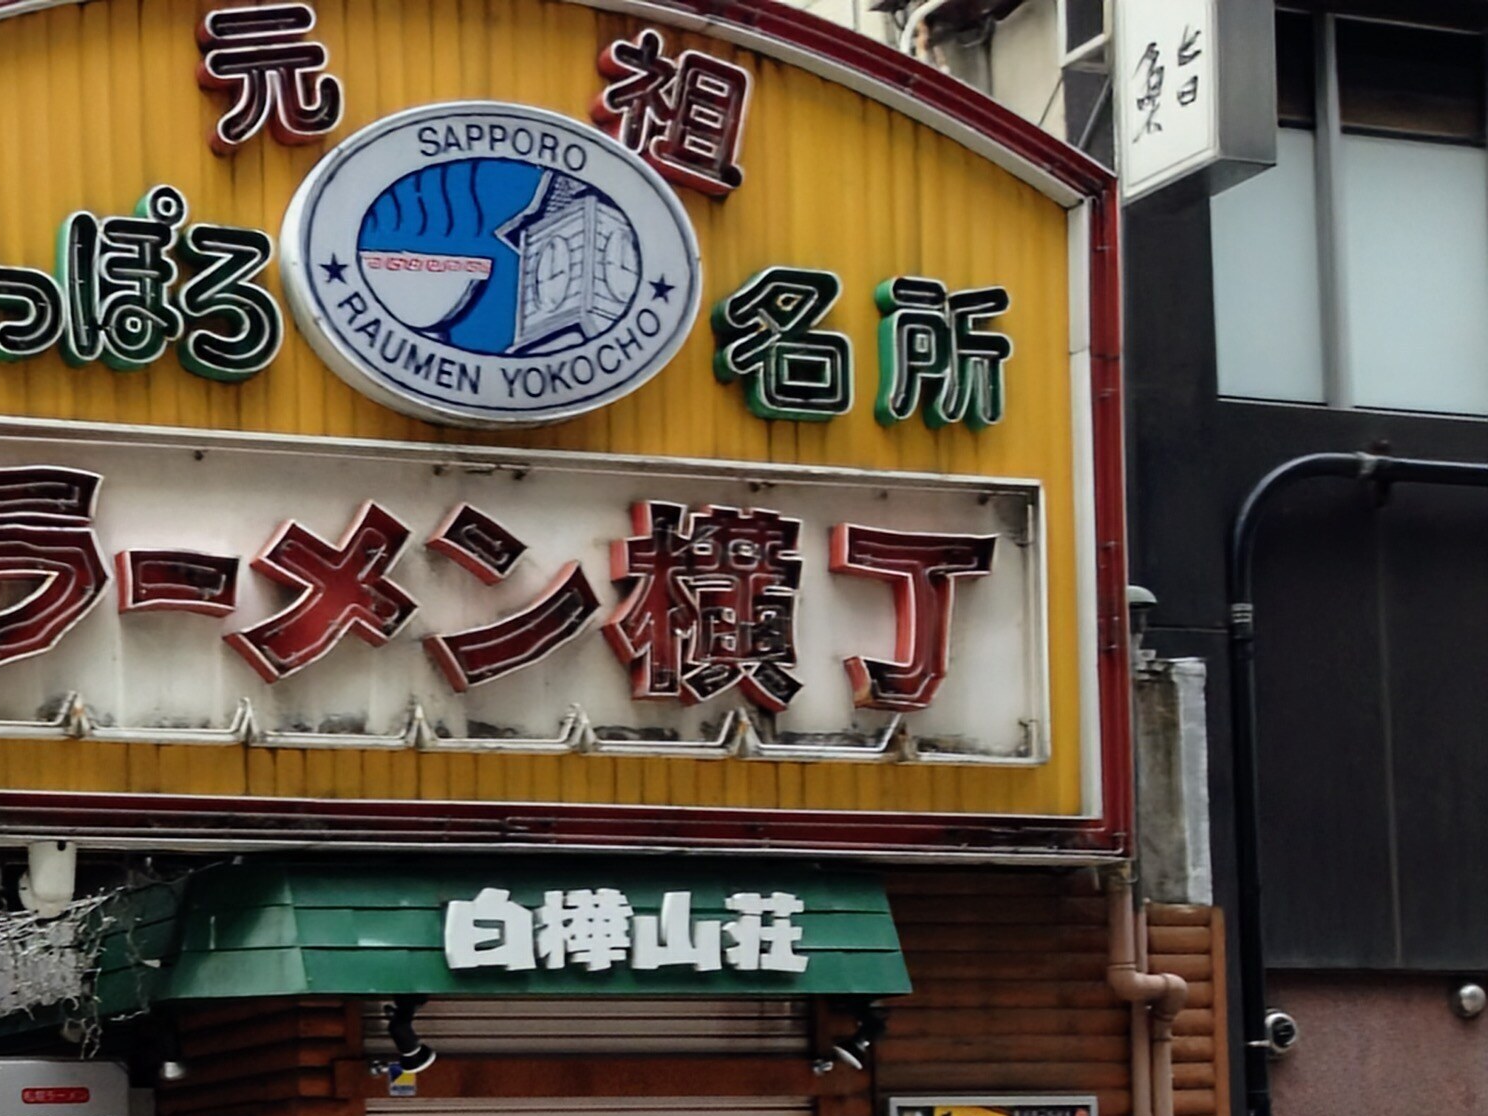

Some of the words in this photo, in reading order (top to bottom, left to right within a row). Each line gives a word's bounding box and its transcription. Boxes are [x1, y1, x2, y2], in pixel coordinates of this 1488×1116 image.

[198, 3, 343, 154] 元
[591, 29, 752, 200] 祖
[417, 125, 587, 173] SAPPORO
[336, 292, 481, 395] RAUMEN
[500, 305, 663, 399] YOKOCHO
[711, 266, 1014, 431] 名所
[444, 887, 809, 972] 白樺山荘
